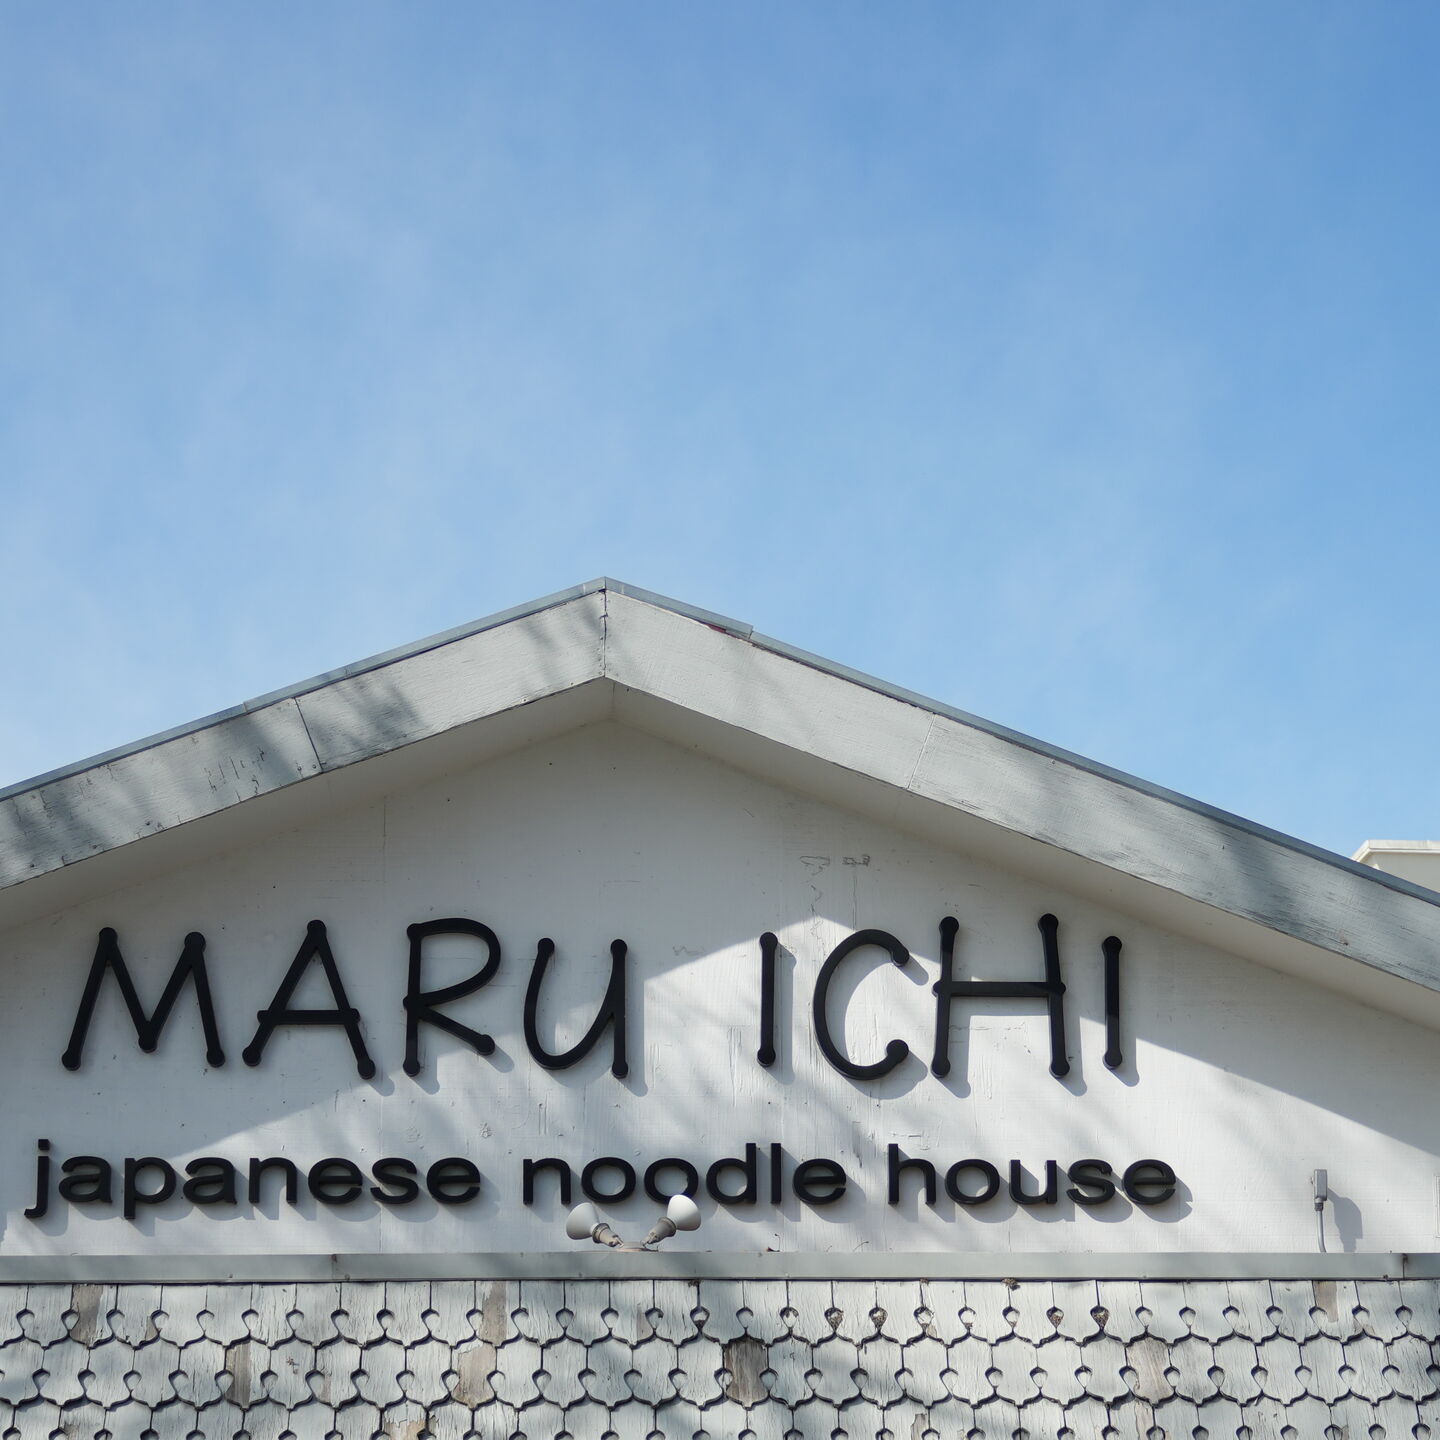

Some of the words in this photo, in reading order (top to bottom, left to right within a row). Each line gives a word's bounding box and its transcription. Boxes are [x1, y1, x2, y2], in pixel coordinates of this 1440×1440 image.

[61, 916, 629, 1080] MARU
[757, 912, 1123, 1081] ICHI
[24, 1139, 481, 1219] japanese
[523, 1142, 847, 1205] noodle
[888, 1143, 1176, 1205] house
